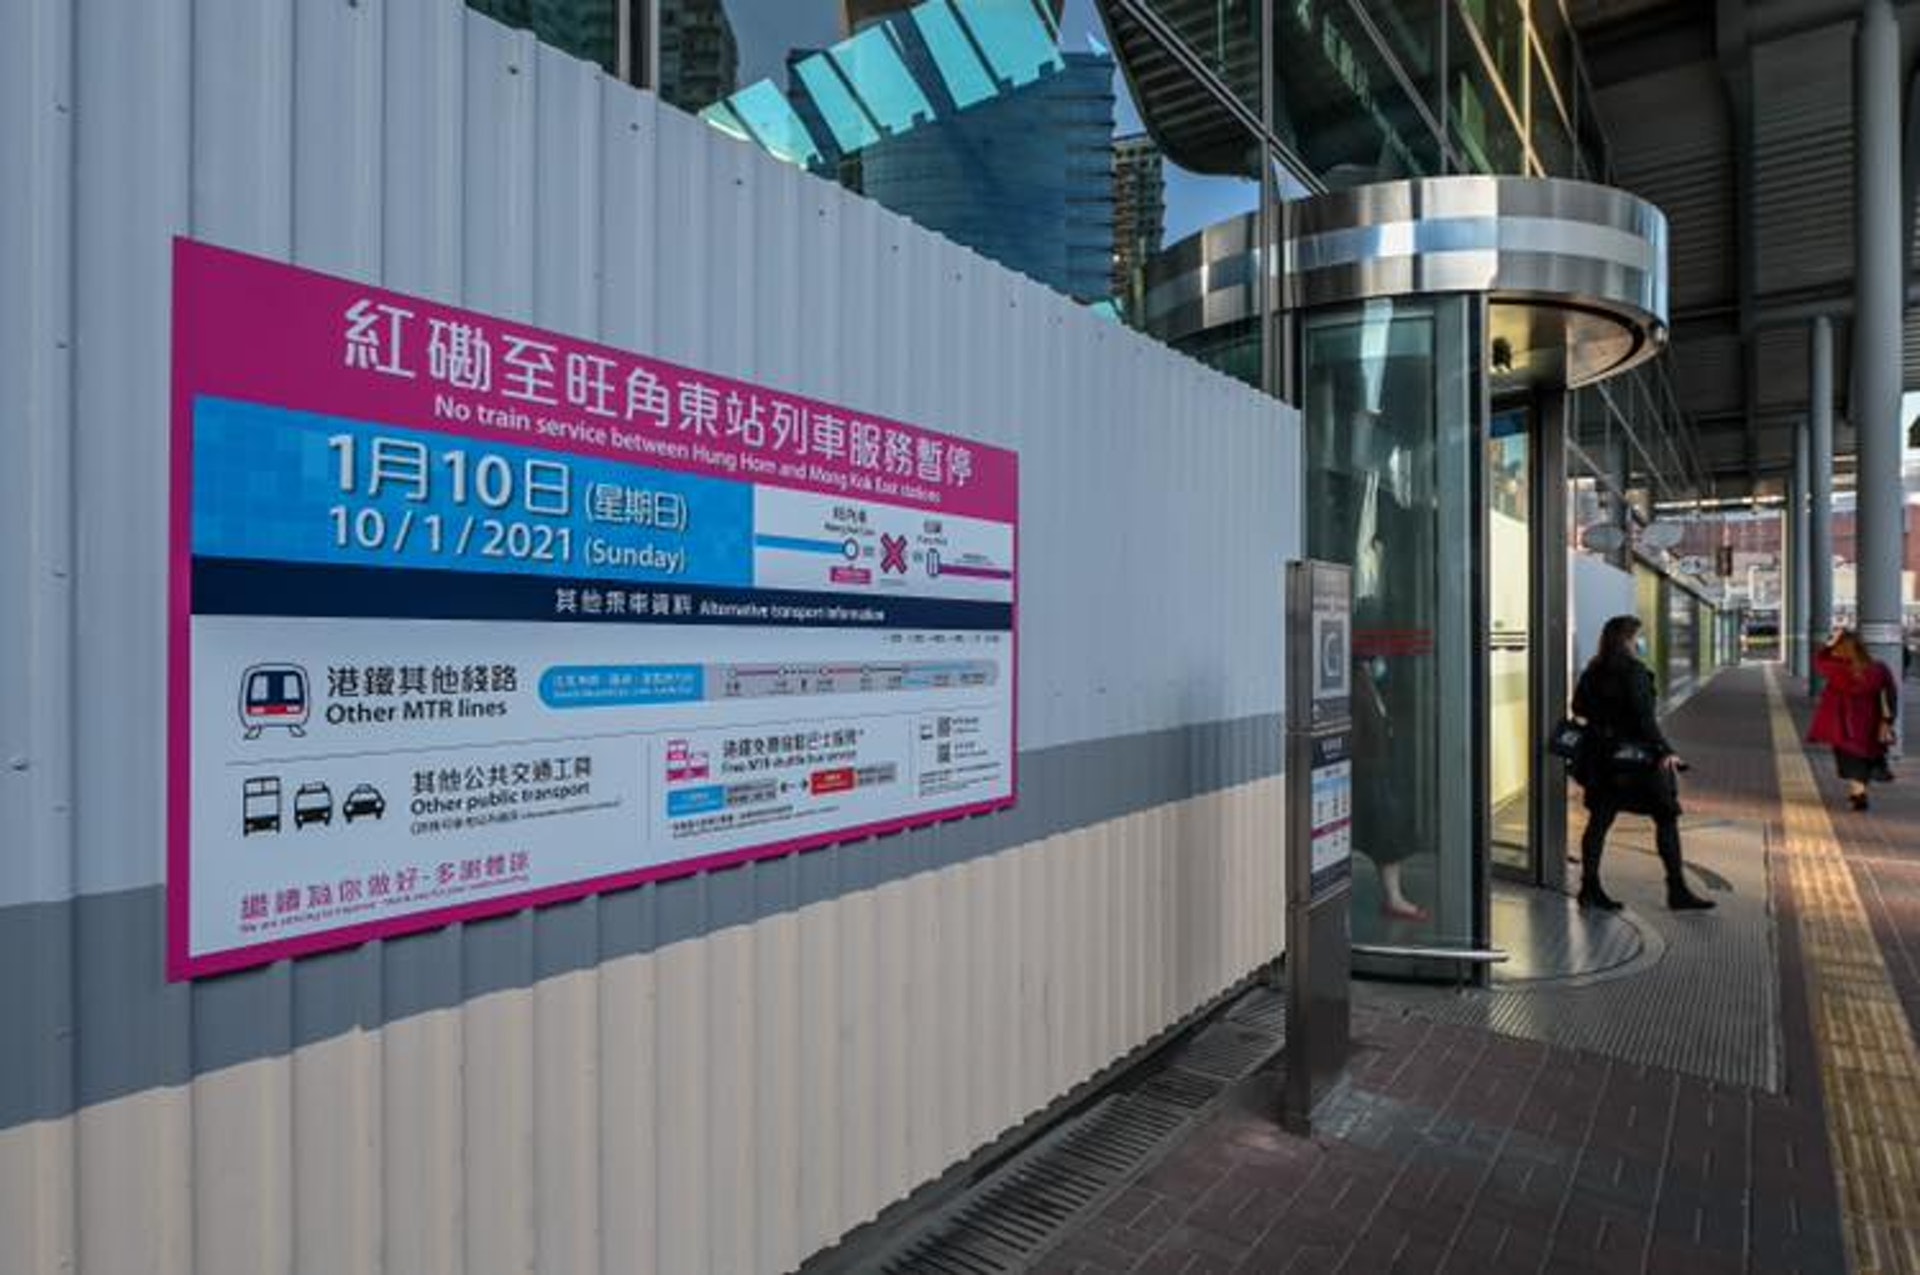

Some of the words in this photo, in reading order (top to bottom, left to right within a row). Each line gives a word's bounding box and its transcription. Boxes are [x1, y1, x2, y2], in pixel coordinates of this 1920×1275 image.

[343, 297, 973, 488] 紅磡至旺角東站列車服務暫停
[434, 395, 470, 421] No
[477, 405, 530, 431] train
[536, 416, 607, 445] service
[611, 428, 689, 459] between
[693, 443, 737, 470] Hung
[740, 452, 777, 472] Hom
[779, 462, 807, 478] and
[809, 464, 847, 489] Mong
[329, 434, 569, 515] 1月10日
[585, 482, 688, 531] (星期日)
[584, 537, 685, 574] (Sunday)
[325, 703, 396, 724] Other
[403, 700, 453, 720] MTR
[458, 699, 508, 718] lines
[411, 797, 462, 815] Other
[467, 790, 519, 813] public
[521, 782, 590, 802] transport
